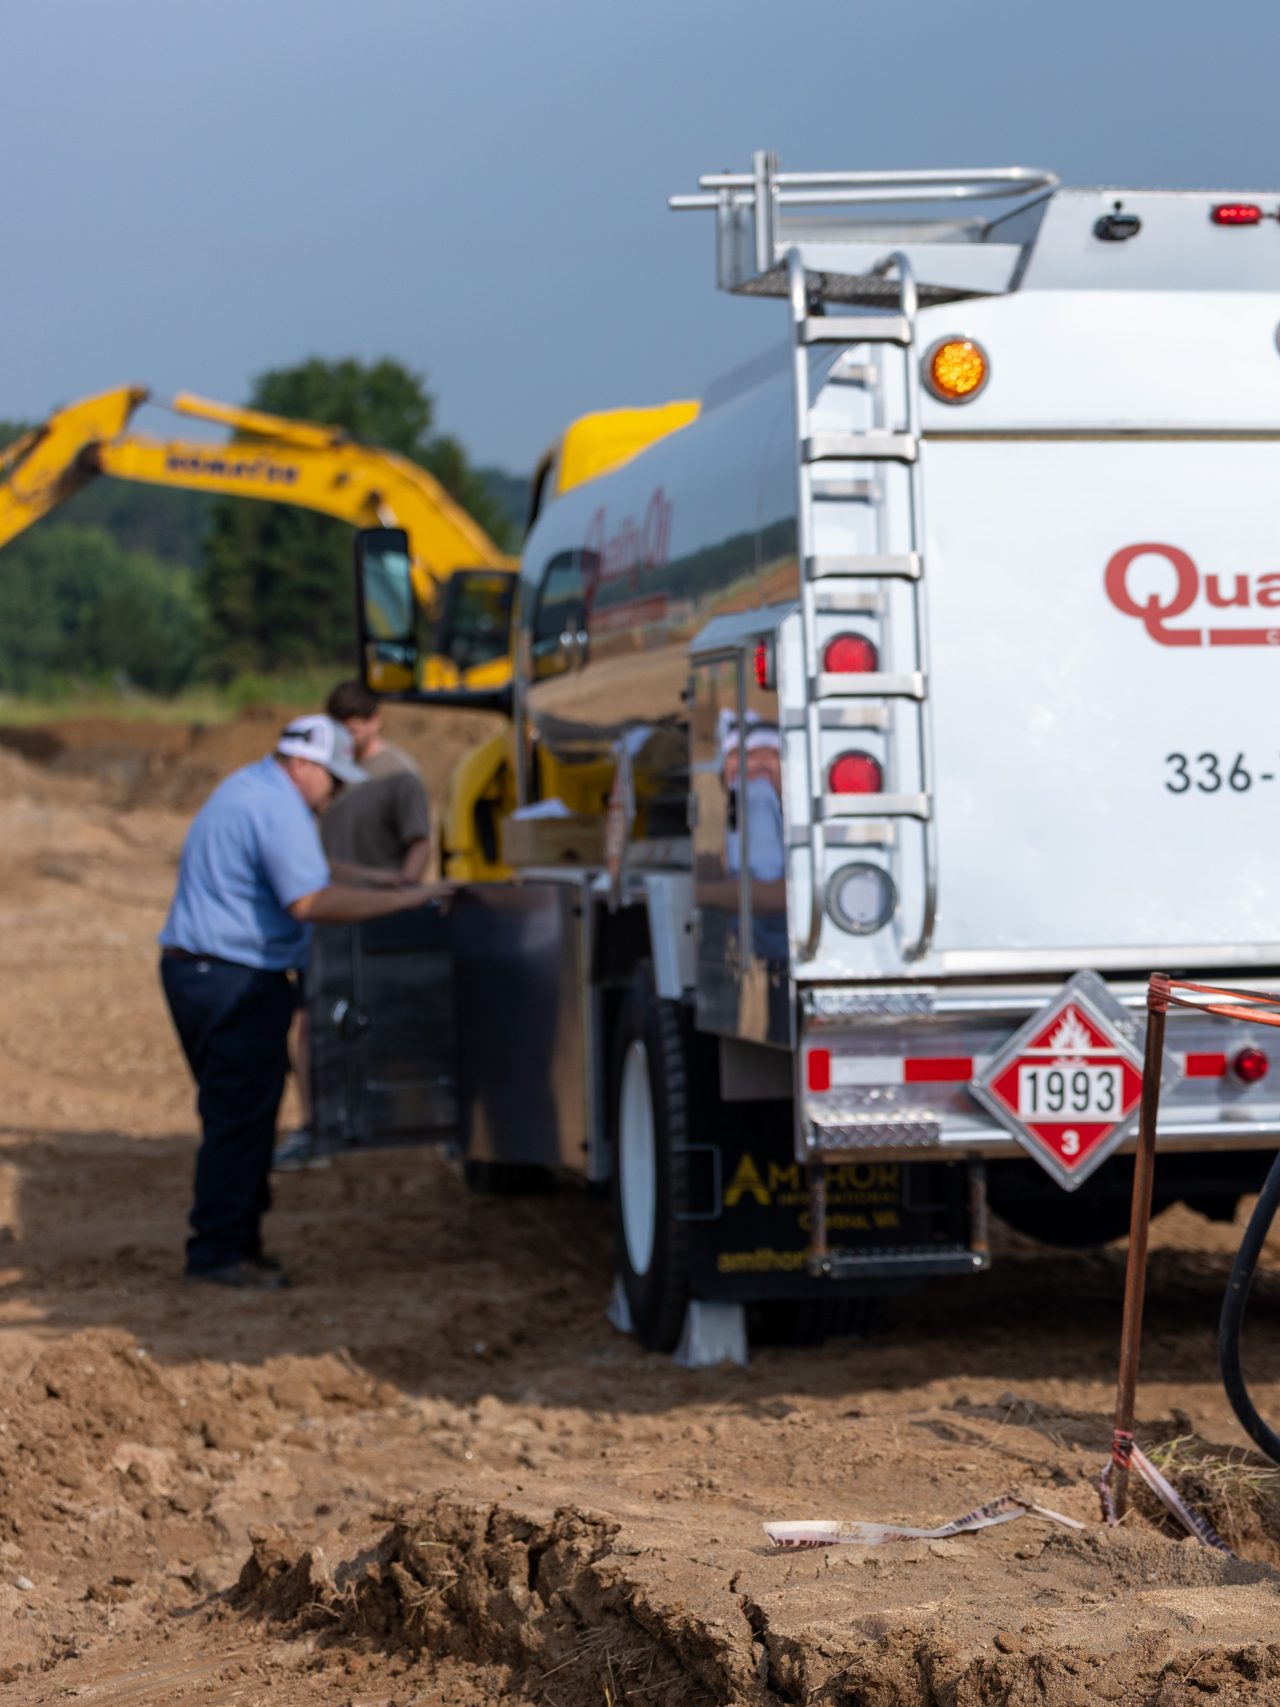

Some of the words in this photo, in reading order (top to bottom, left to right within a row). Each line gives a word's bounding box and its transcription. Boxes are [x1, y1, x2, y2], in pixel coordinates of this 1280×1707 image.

[1027, 1071, 1115, 1112] 1993
[1060, 1129, 1080, 1156] 3
[724, 1152, 902, 1207] AMHOR
